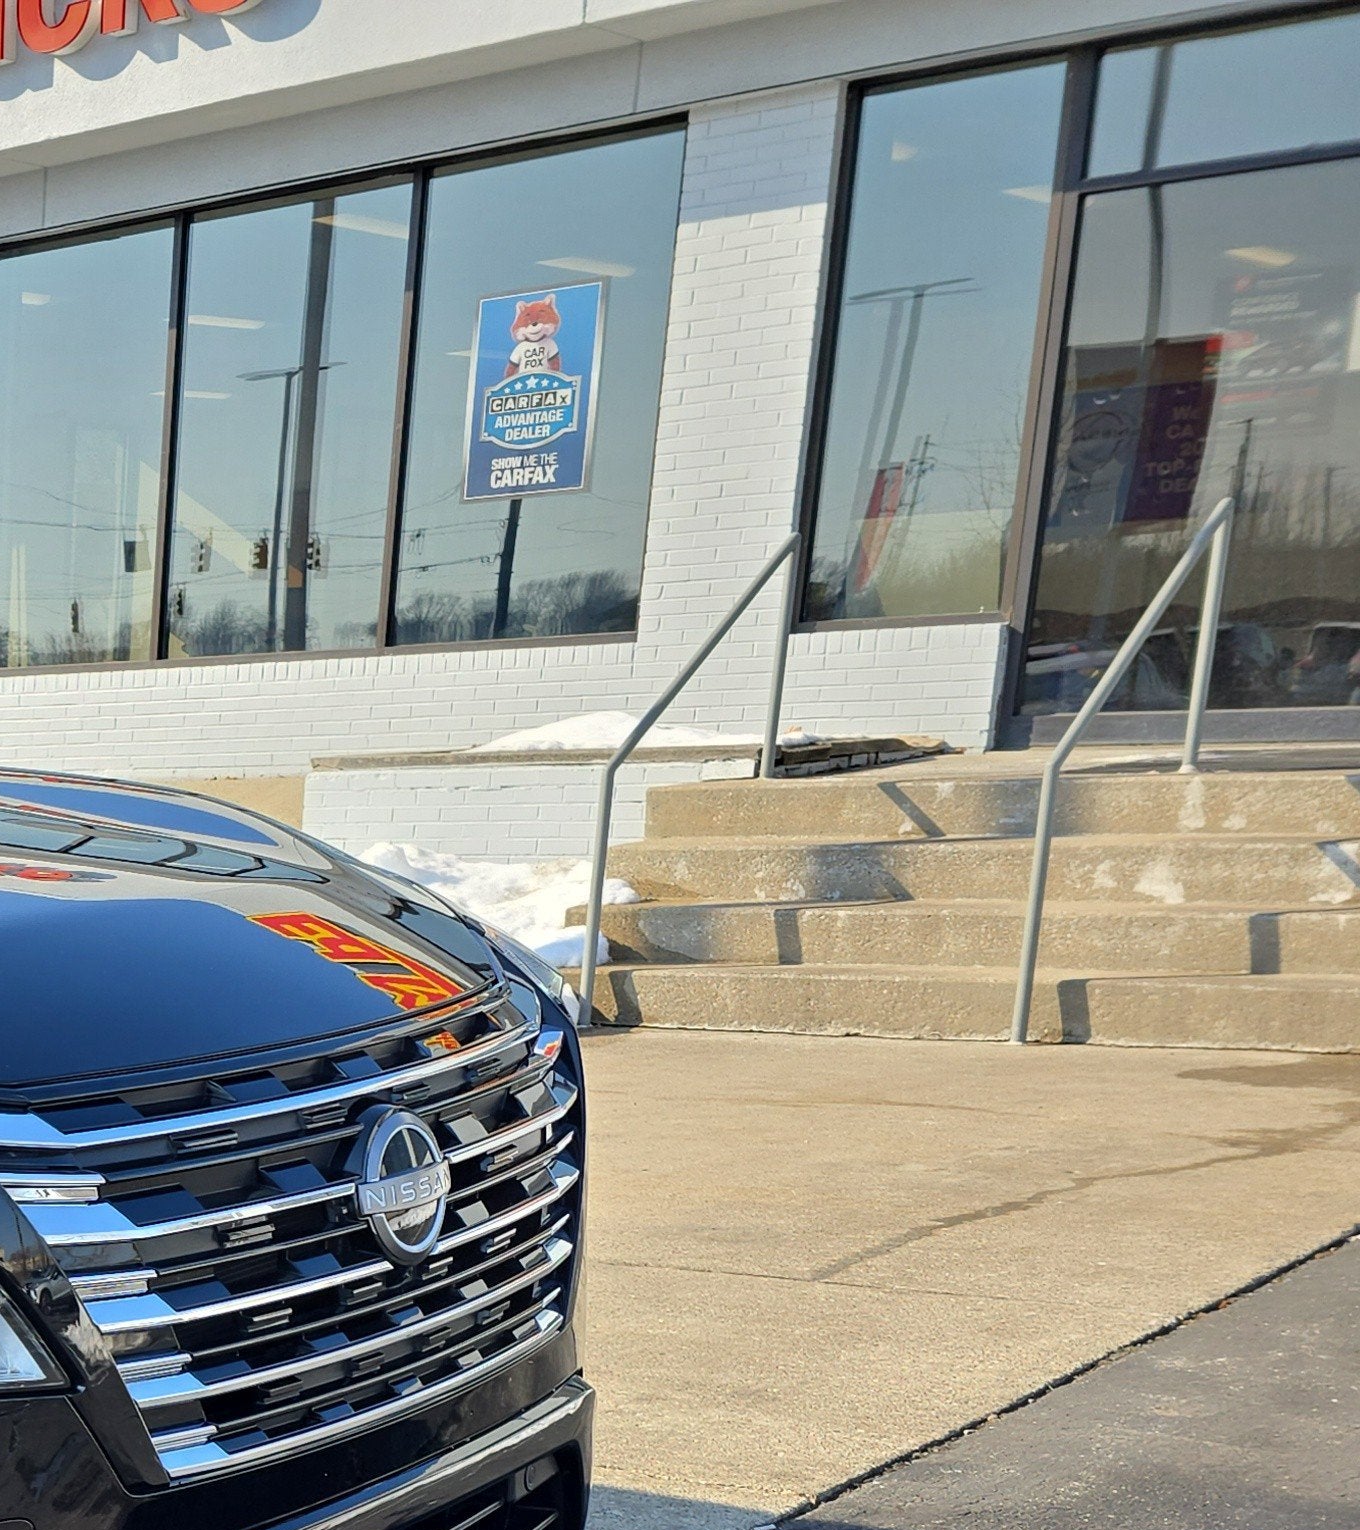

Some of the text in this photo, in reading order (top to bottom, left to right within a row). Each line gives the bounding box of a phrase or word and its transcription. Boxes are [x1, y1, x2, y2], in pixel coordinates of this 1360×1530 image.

[524, 346, 545, 359] CAR
[524, 358, 543, 369] FOX
[491, 391, 568, 413] CARFAX
[494, 409, 564, 428] ADVANTAGE
[505, 424, 551, 441] DEALER
[491, 452, 558, 470] SHOW ME THE
[491, 465, 558, 488] CARFAX
[365, 1169, 450, 1209] NISSAN
